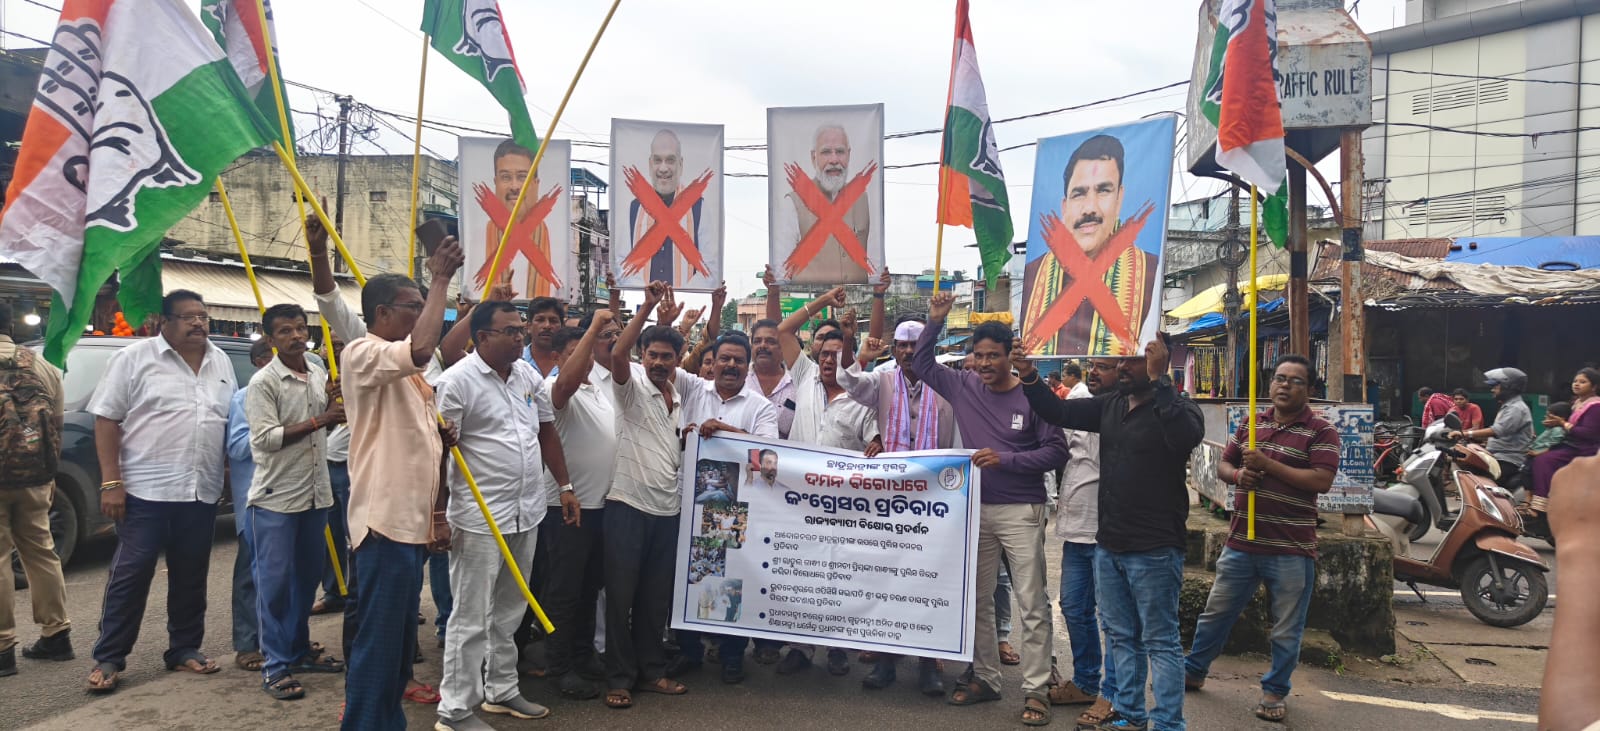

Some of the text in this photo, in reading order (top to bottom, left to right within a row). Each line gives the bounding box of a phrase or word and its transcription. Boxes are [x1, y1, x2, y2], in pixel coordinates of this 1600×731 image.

[1280, 69, 1359, 99] RAFFIC RULE
[804, 472, 928, 492] ଦମନ ବିରୋଧରେ
[785, 490, 949, 518] କଂଗ୍ରେସର ପ୍ରତିବାଦ
[804, 515, 929, 535] ରାଜ୍ୟବ୍ୟାପୀ ବିକ୍ଷୋଭ ପ୍ରଦର୍ଶନ
[773, 542, 799, 551] ପ୍ରତିବାଦ
[826, 572, 852, 580] ପ୍ରତିବାଦ
[816, 598, 842, 607] ପ୍ରତିବାଦ
